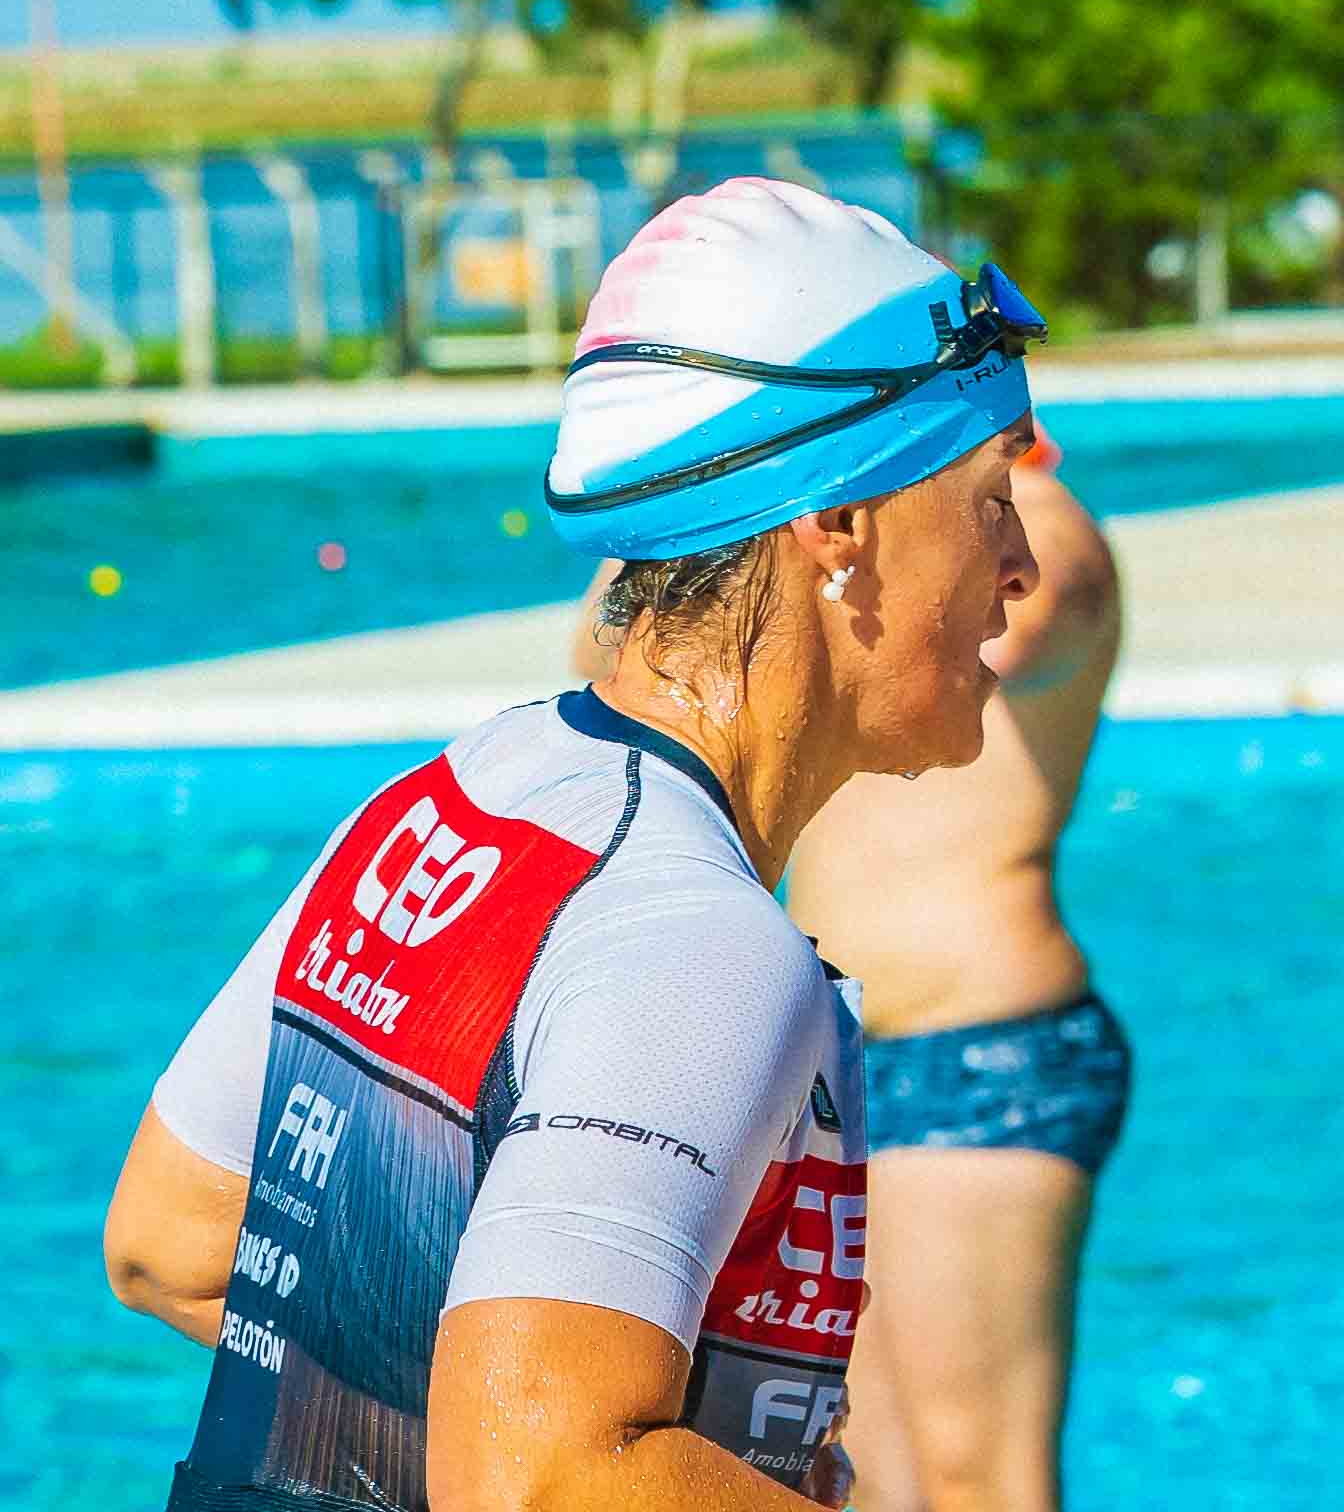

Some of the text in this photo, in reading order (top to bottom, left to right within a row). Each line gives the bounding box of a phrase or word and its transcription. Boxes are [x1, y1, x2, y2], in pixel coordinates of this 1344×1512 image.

[353, 795, 502, 948] CEO
[547, 1115, 716, 1177] ORBITAL
[220, 1310, 286, 1374] PELOTÓN
